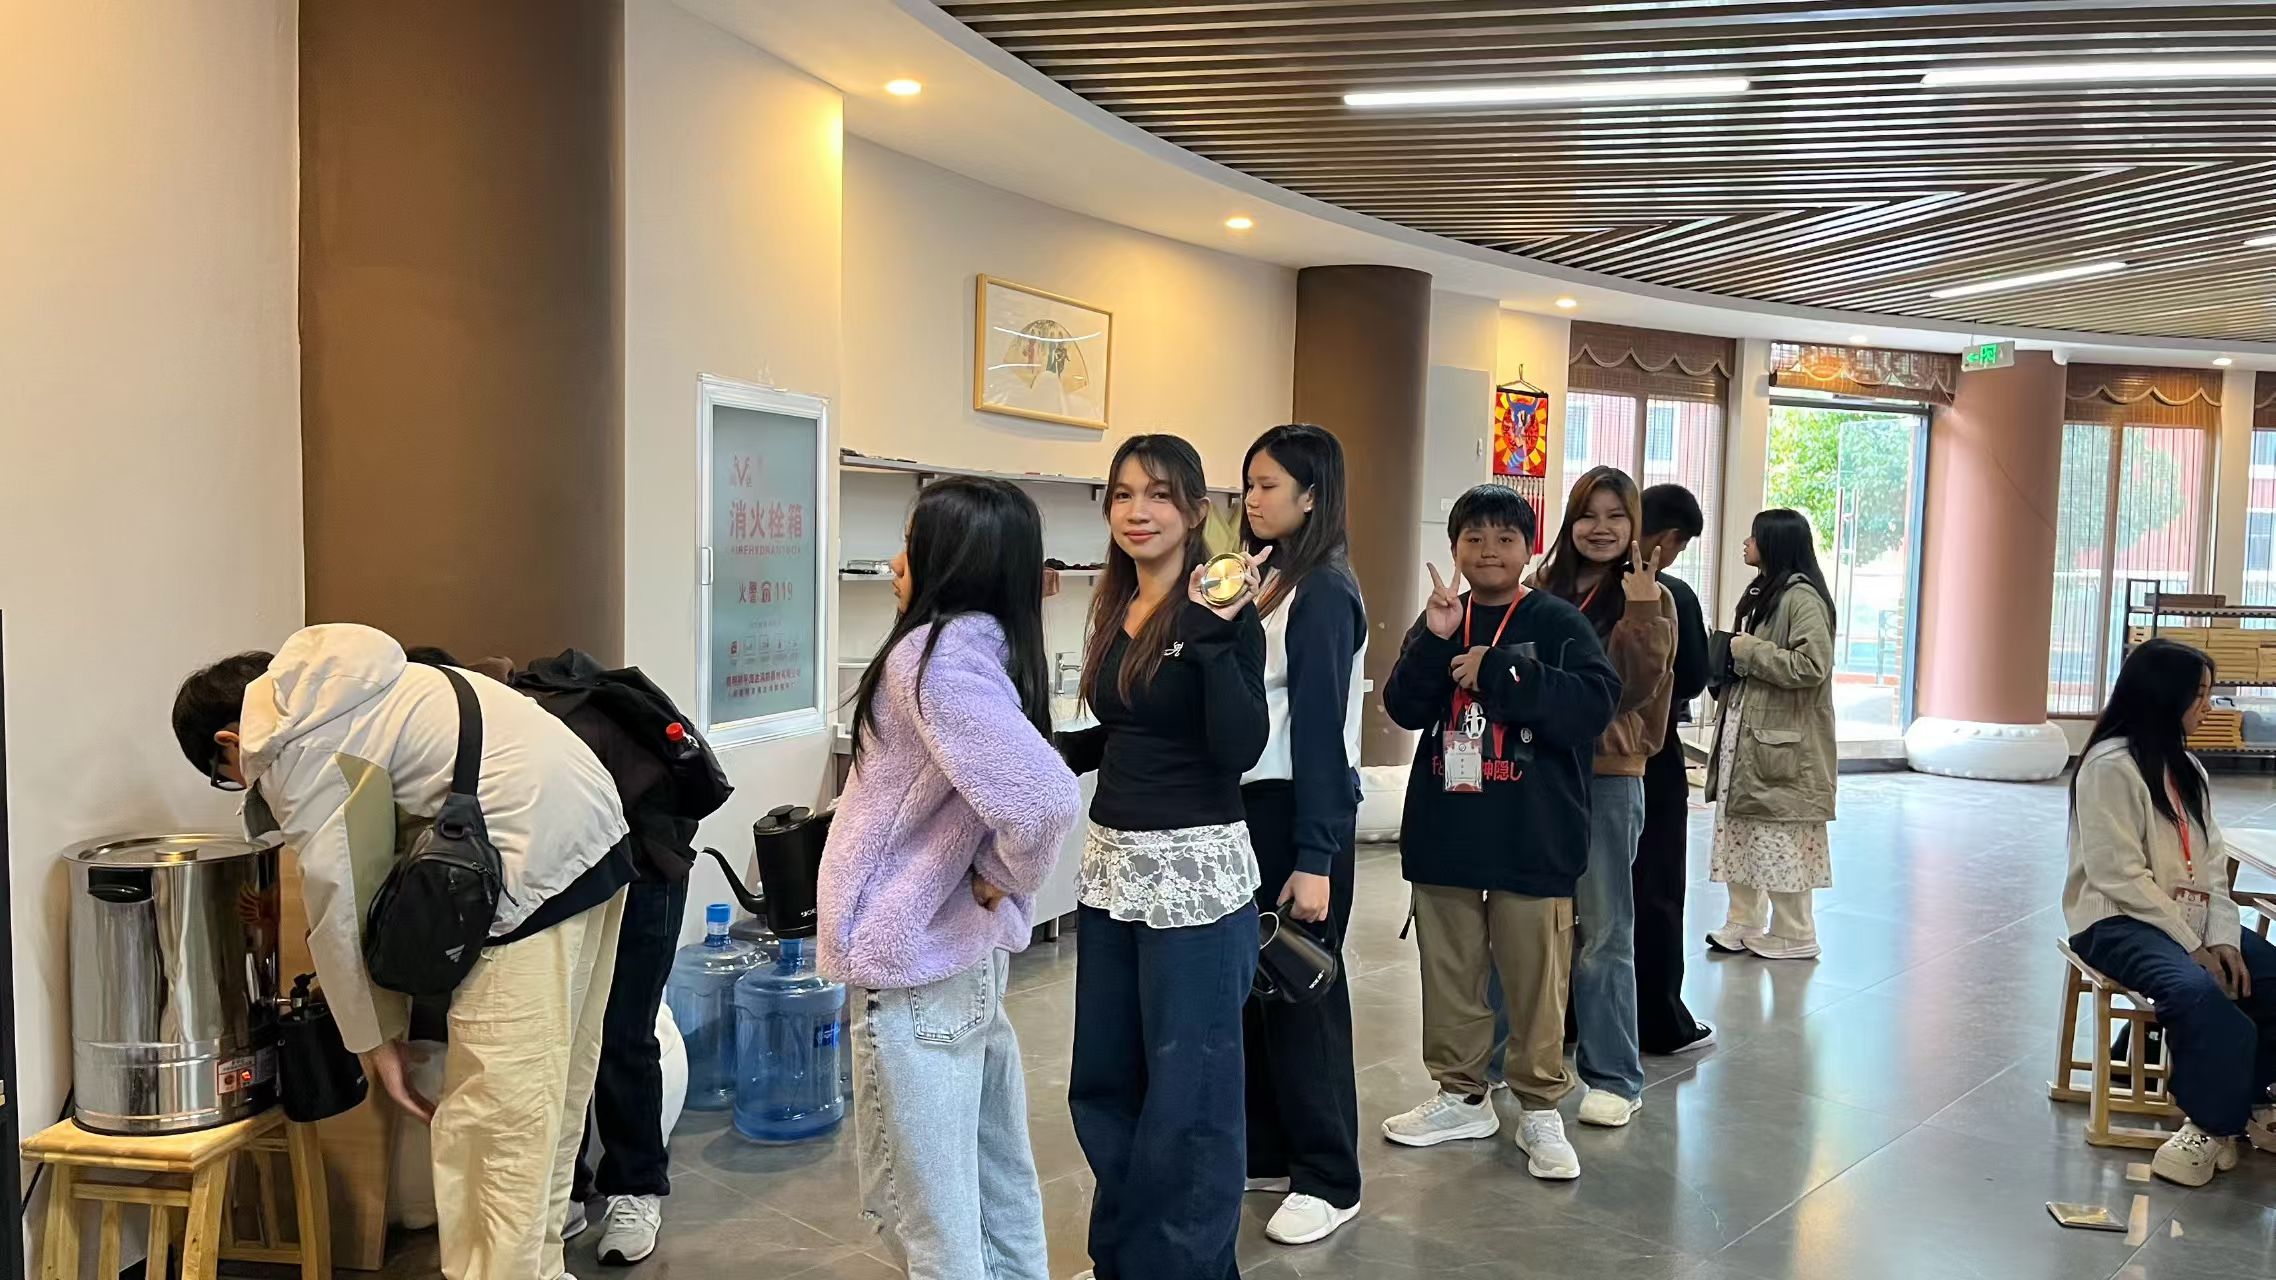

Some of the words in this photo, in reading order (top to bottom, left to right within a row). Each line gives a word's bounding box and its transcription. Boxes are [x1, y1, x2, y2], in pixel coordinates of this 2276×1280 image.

[730, 500, 802, 539] 消火栓箱
[776, 581, 793, 601] 119
